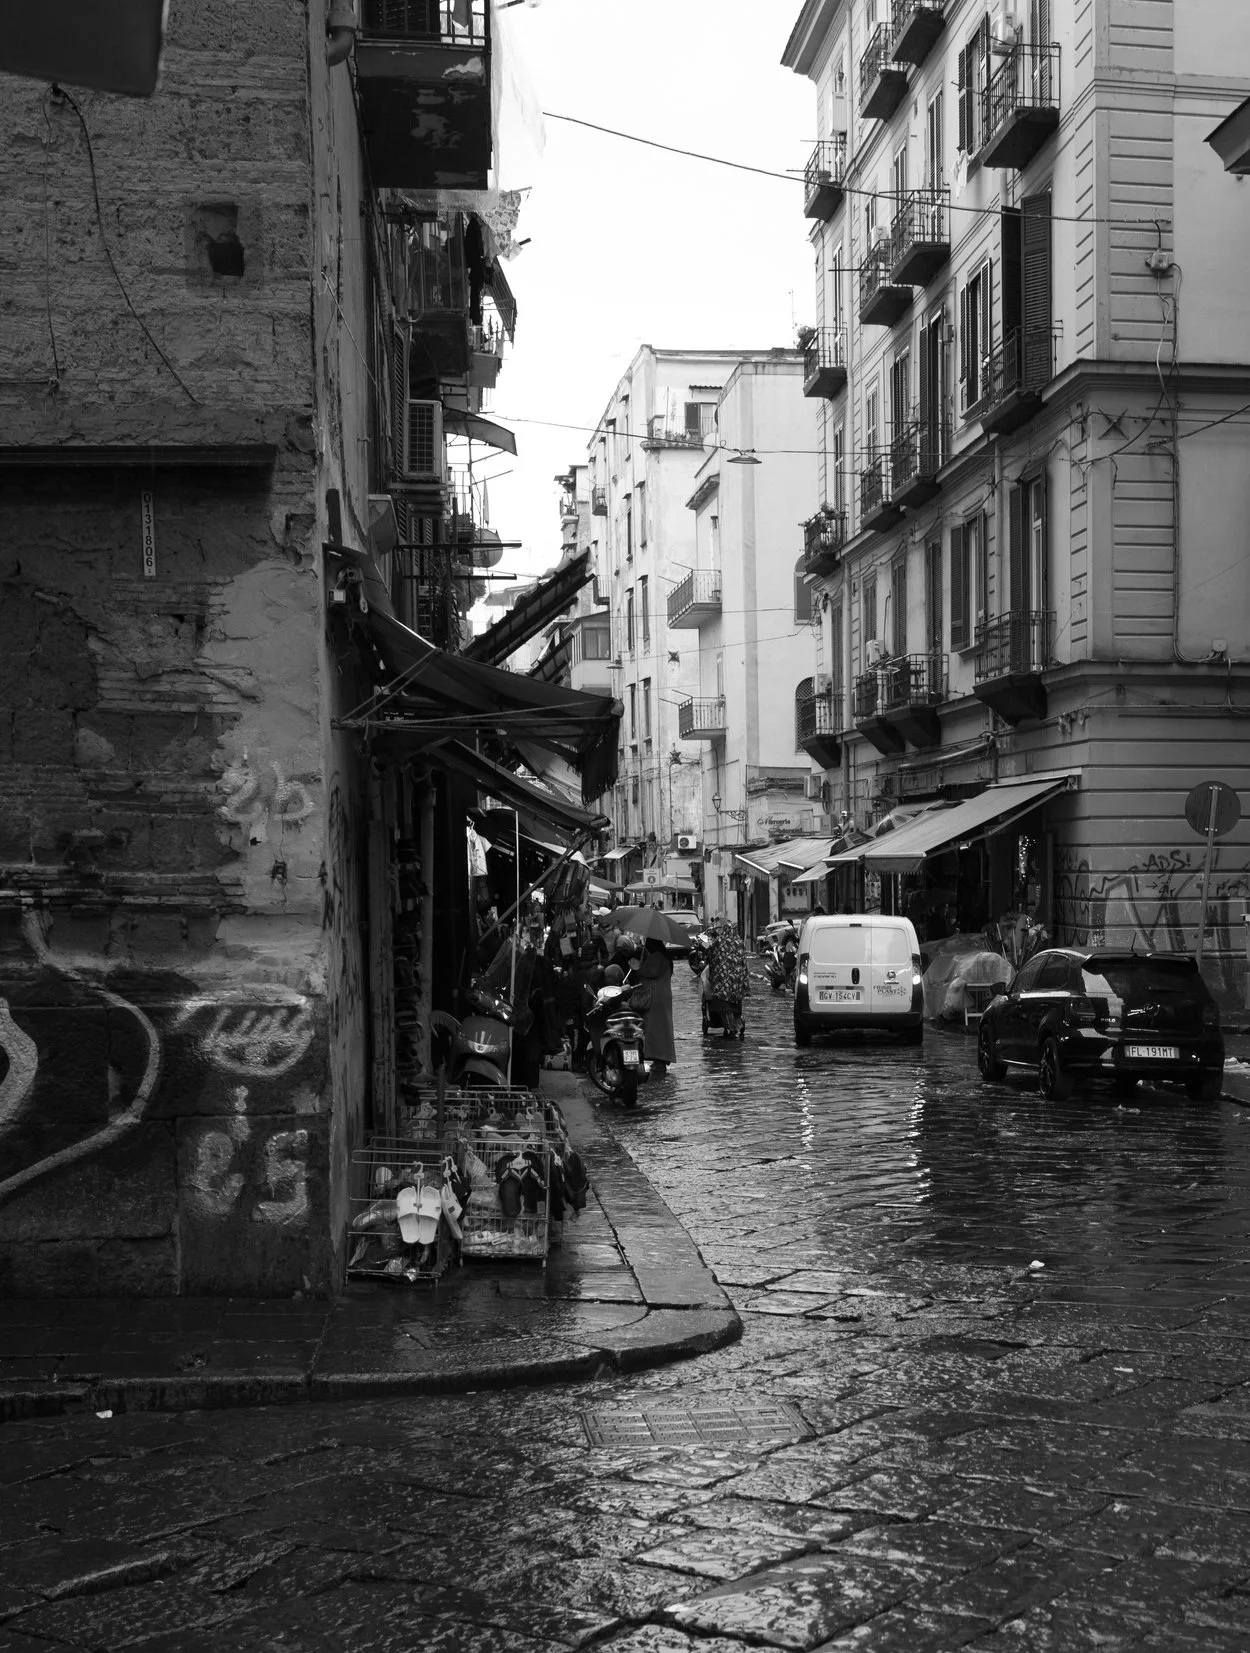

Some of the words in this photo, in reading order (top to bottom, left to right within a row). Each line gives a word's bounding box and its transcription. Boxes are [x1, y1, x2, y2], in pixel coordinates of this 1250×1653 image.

[143, 492, 154, 568] 0131806
[823, 991, 832, 1000] GV
[1131, 1046, 1142, 1057] FL
[1146, 1047, 1173, 1057] 191MT
